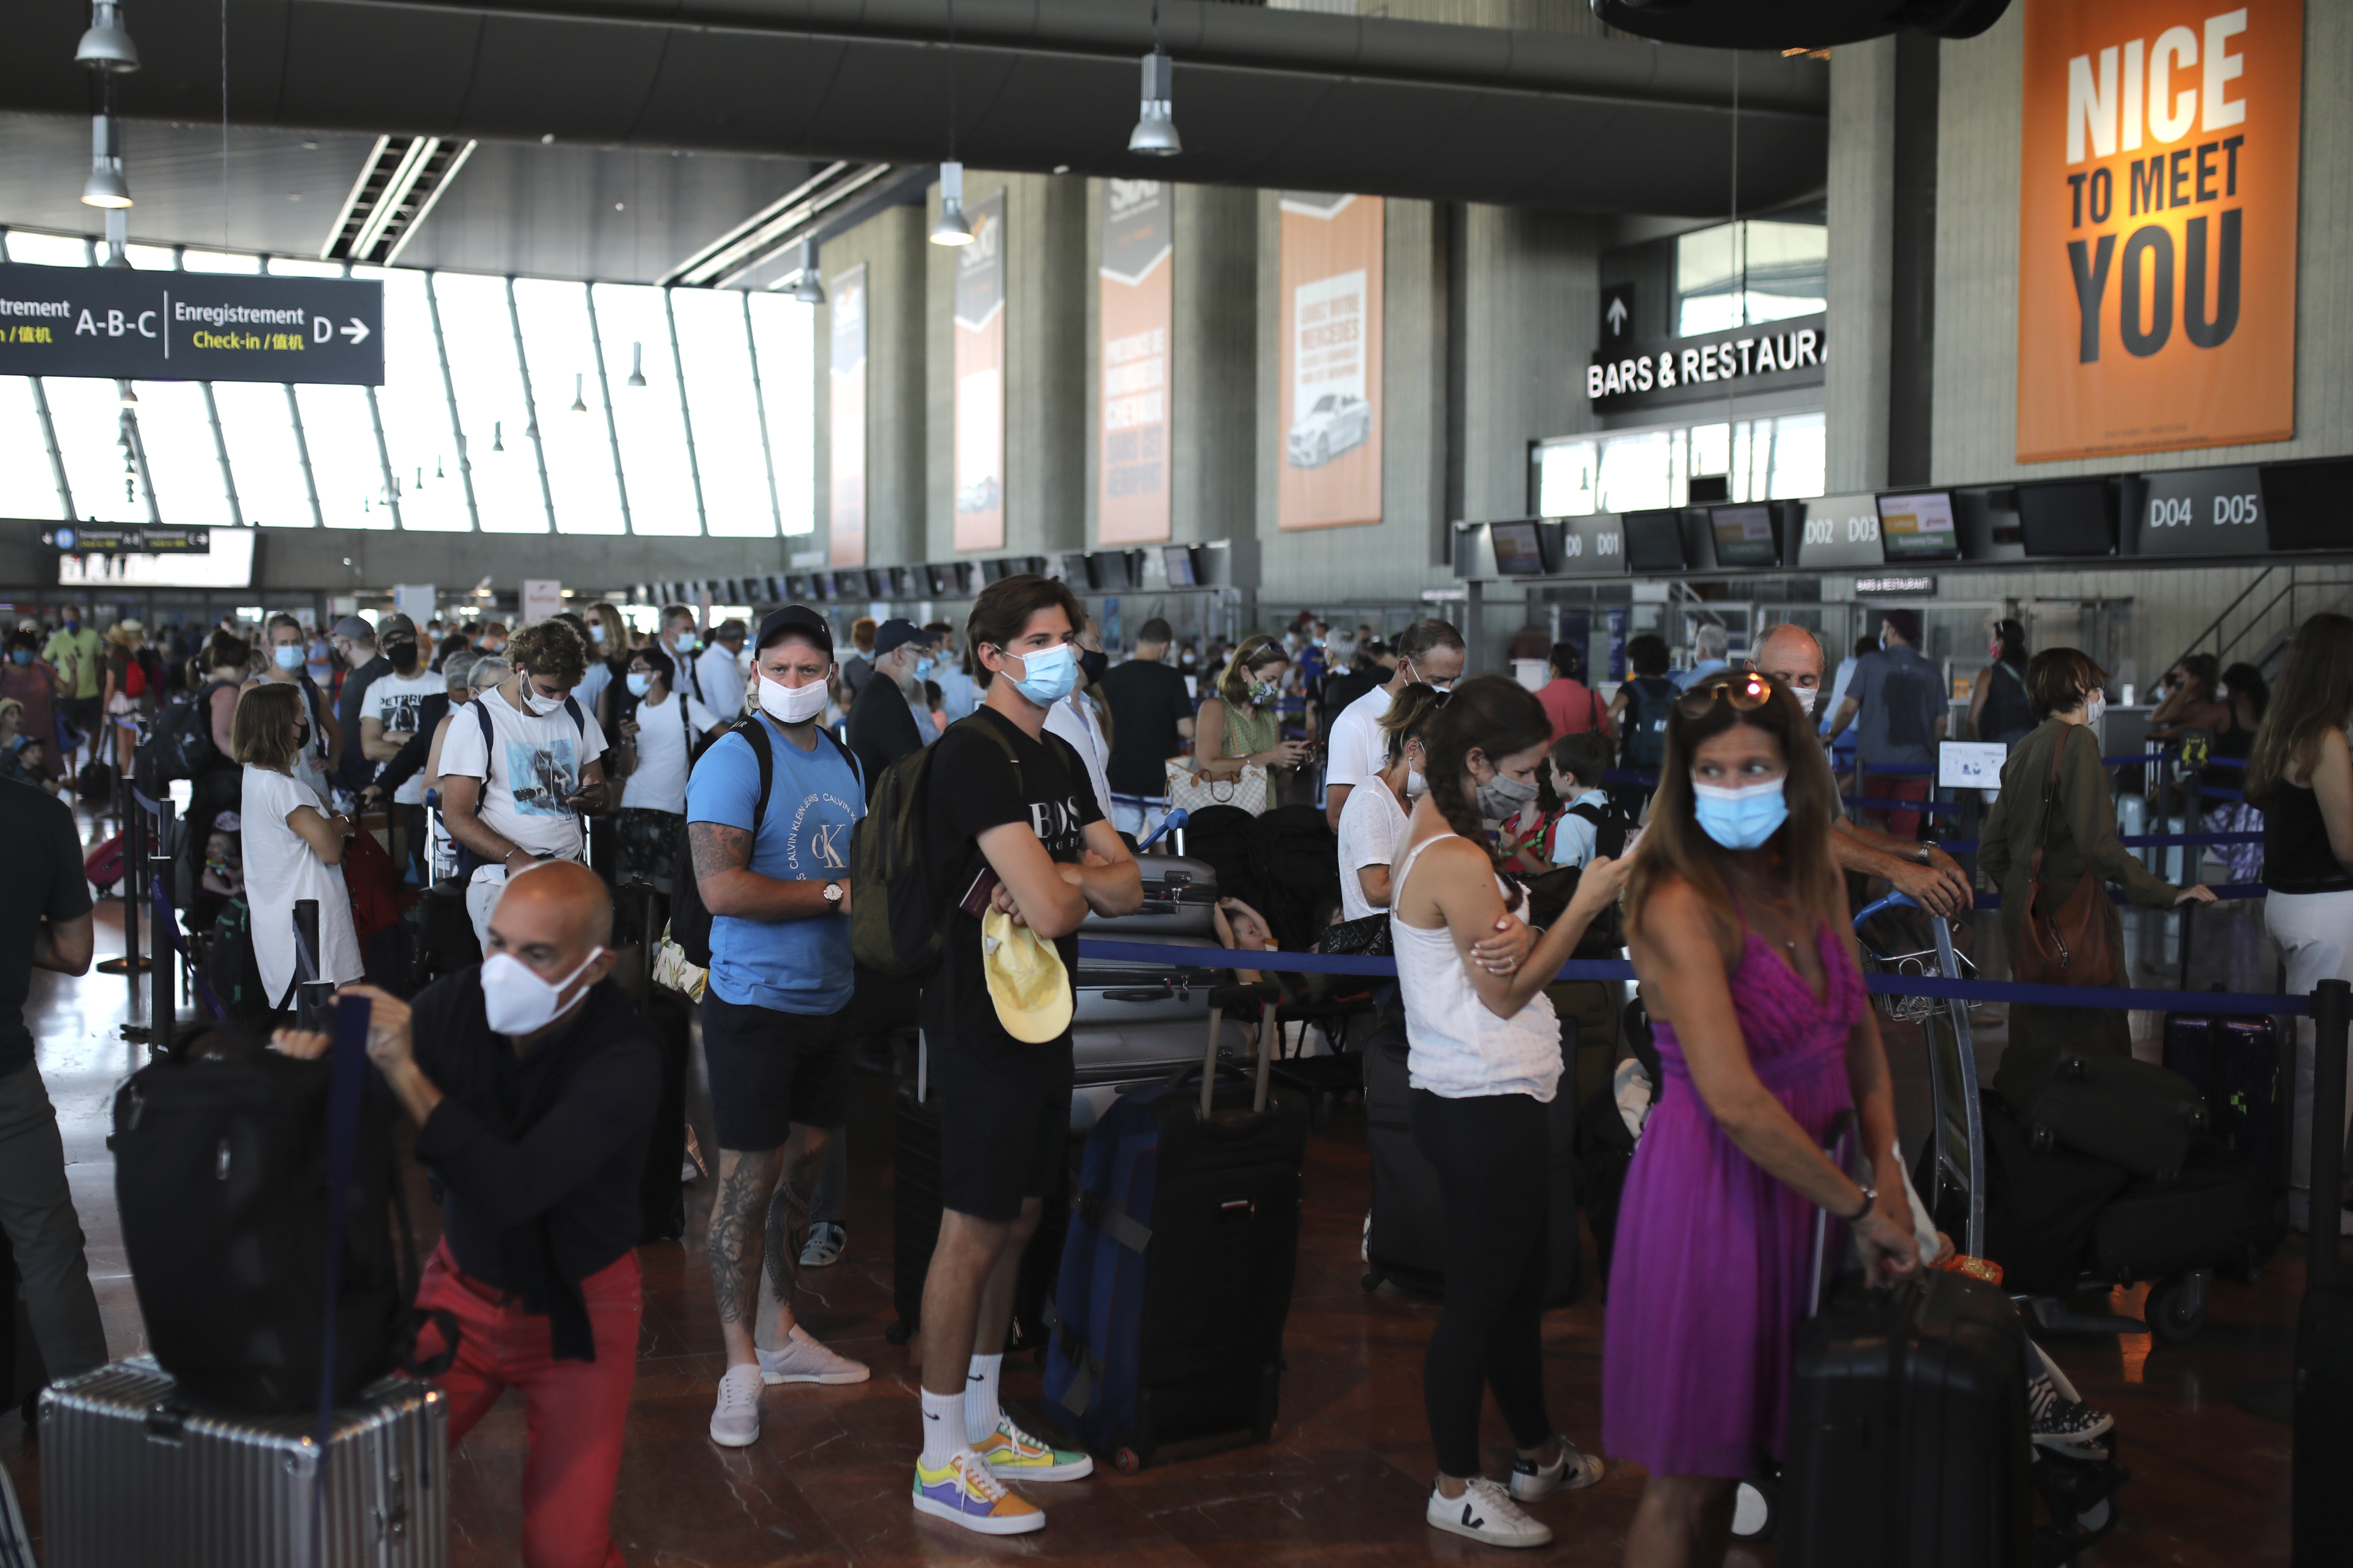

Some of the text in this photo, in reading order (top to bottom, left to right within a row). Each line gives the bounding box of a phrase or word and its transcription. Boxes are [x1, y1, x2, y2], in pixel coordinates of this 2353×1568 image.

[2066, 7, 2247, 165] NICE
[2067, 134, 2244, 229] TO MEET
[2066, 207, 2243, 365] YOU
[74, 308, 157, 339] A-B-C
[175, 301, 305, 327] Enregistrement
[313, 316, 333, 344] D
[193, 330, 261, 350] Check-in
[1587, 356, 1654, 399] BARS
[1657, 351, 1677, 389] &
[2150, 494, 2258, 528] D04 D05
[1565, 532, 1619, 557] D0 D01
[1806, 515, 1878, 545] D02 D03
[822, 793, 851, 813] CALVIN
[1028, 796, 1081, 838] BOS
[787, 793, 819, 870] CALVIN KLEIN JEANS
